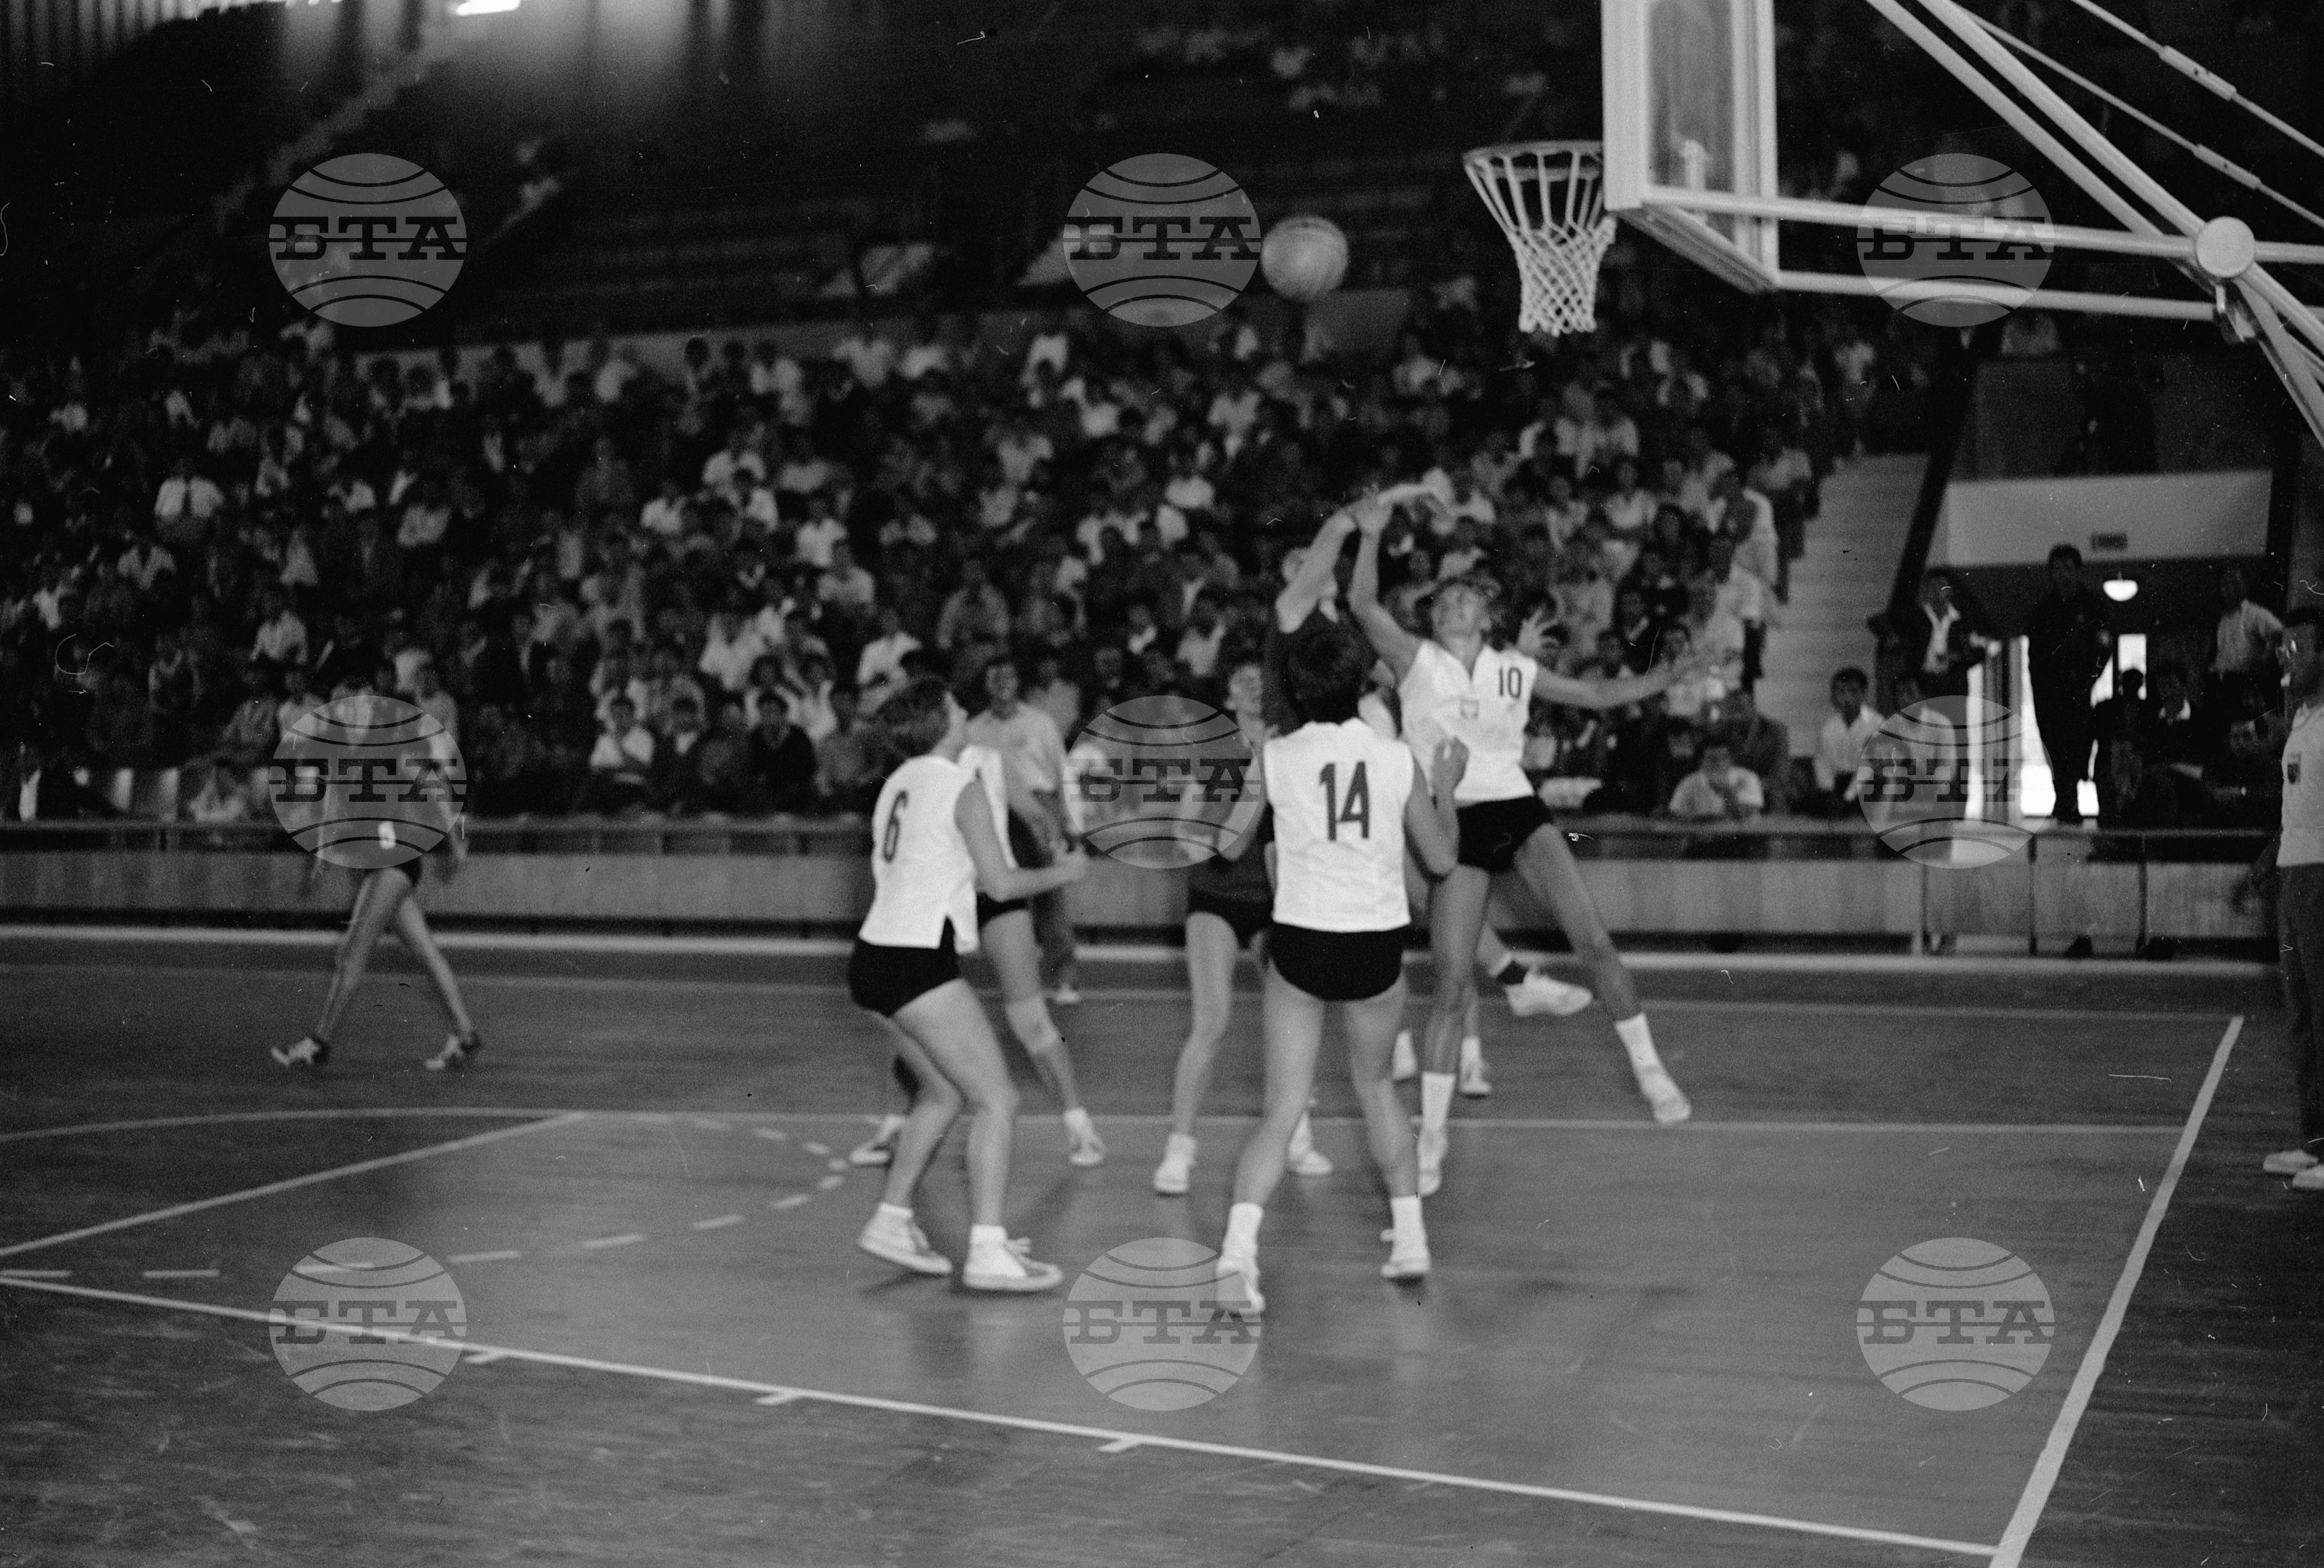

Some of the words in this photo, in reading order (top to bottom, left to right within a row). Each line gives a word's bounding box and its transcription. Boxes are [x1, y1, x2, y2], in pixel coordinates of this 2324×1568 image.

[1499, 668, 1522, 698] 10
[883, 791, 907, 862] 6
[1319, 761, 1369, 841] 14
